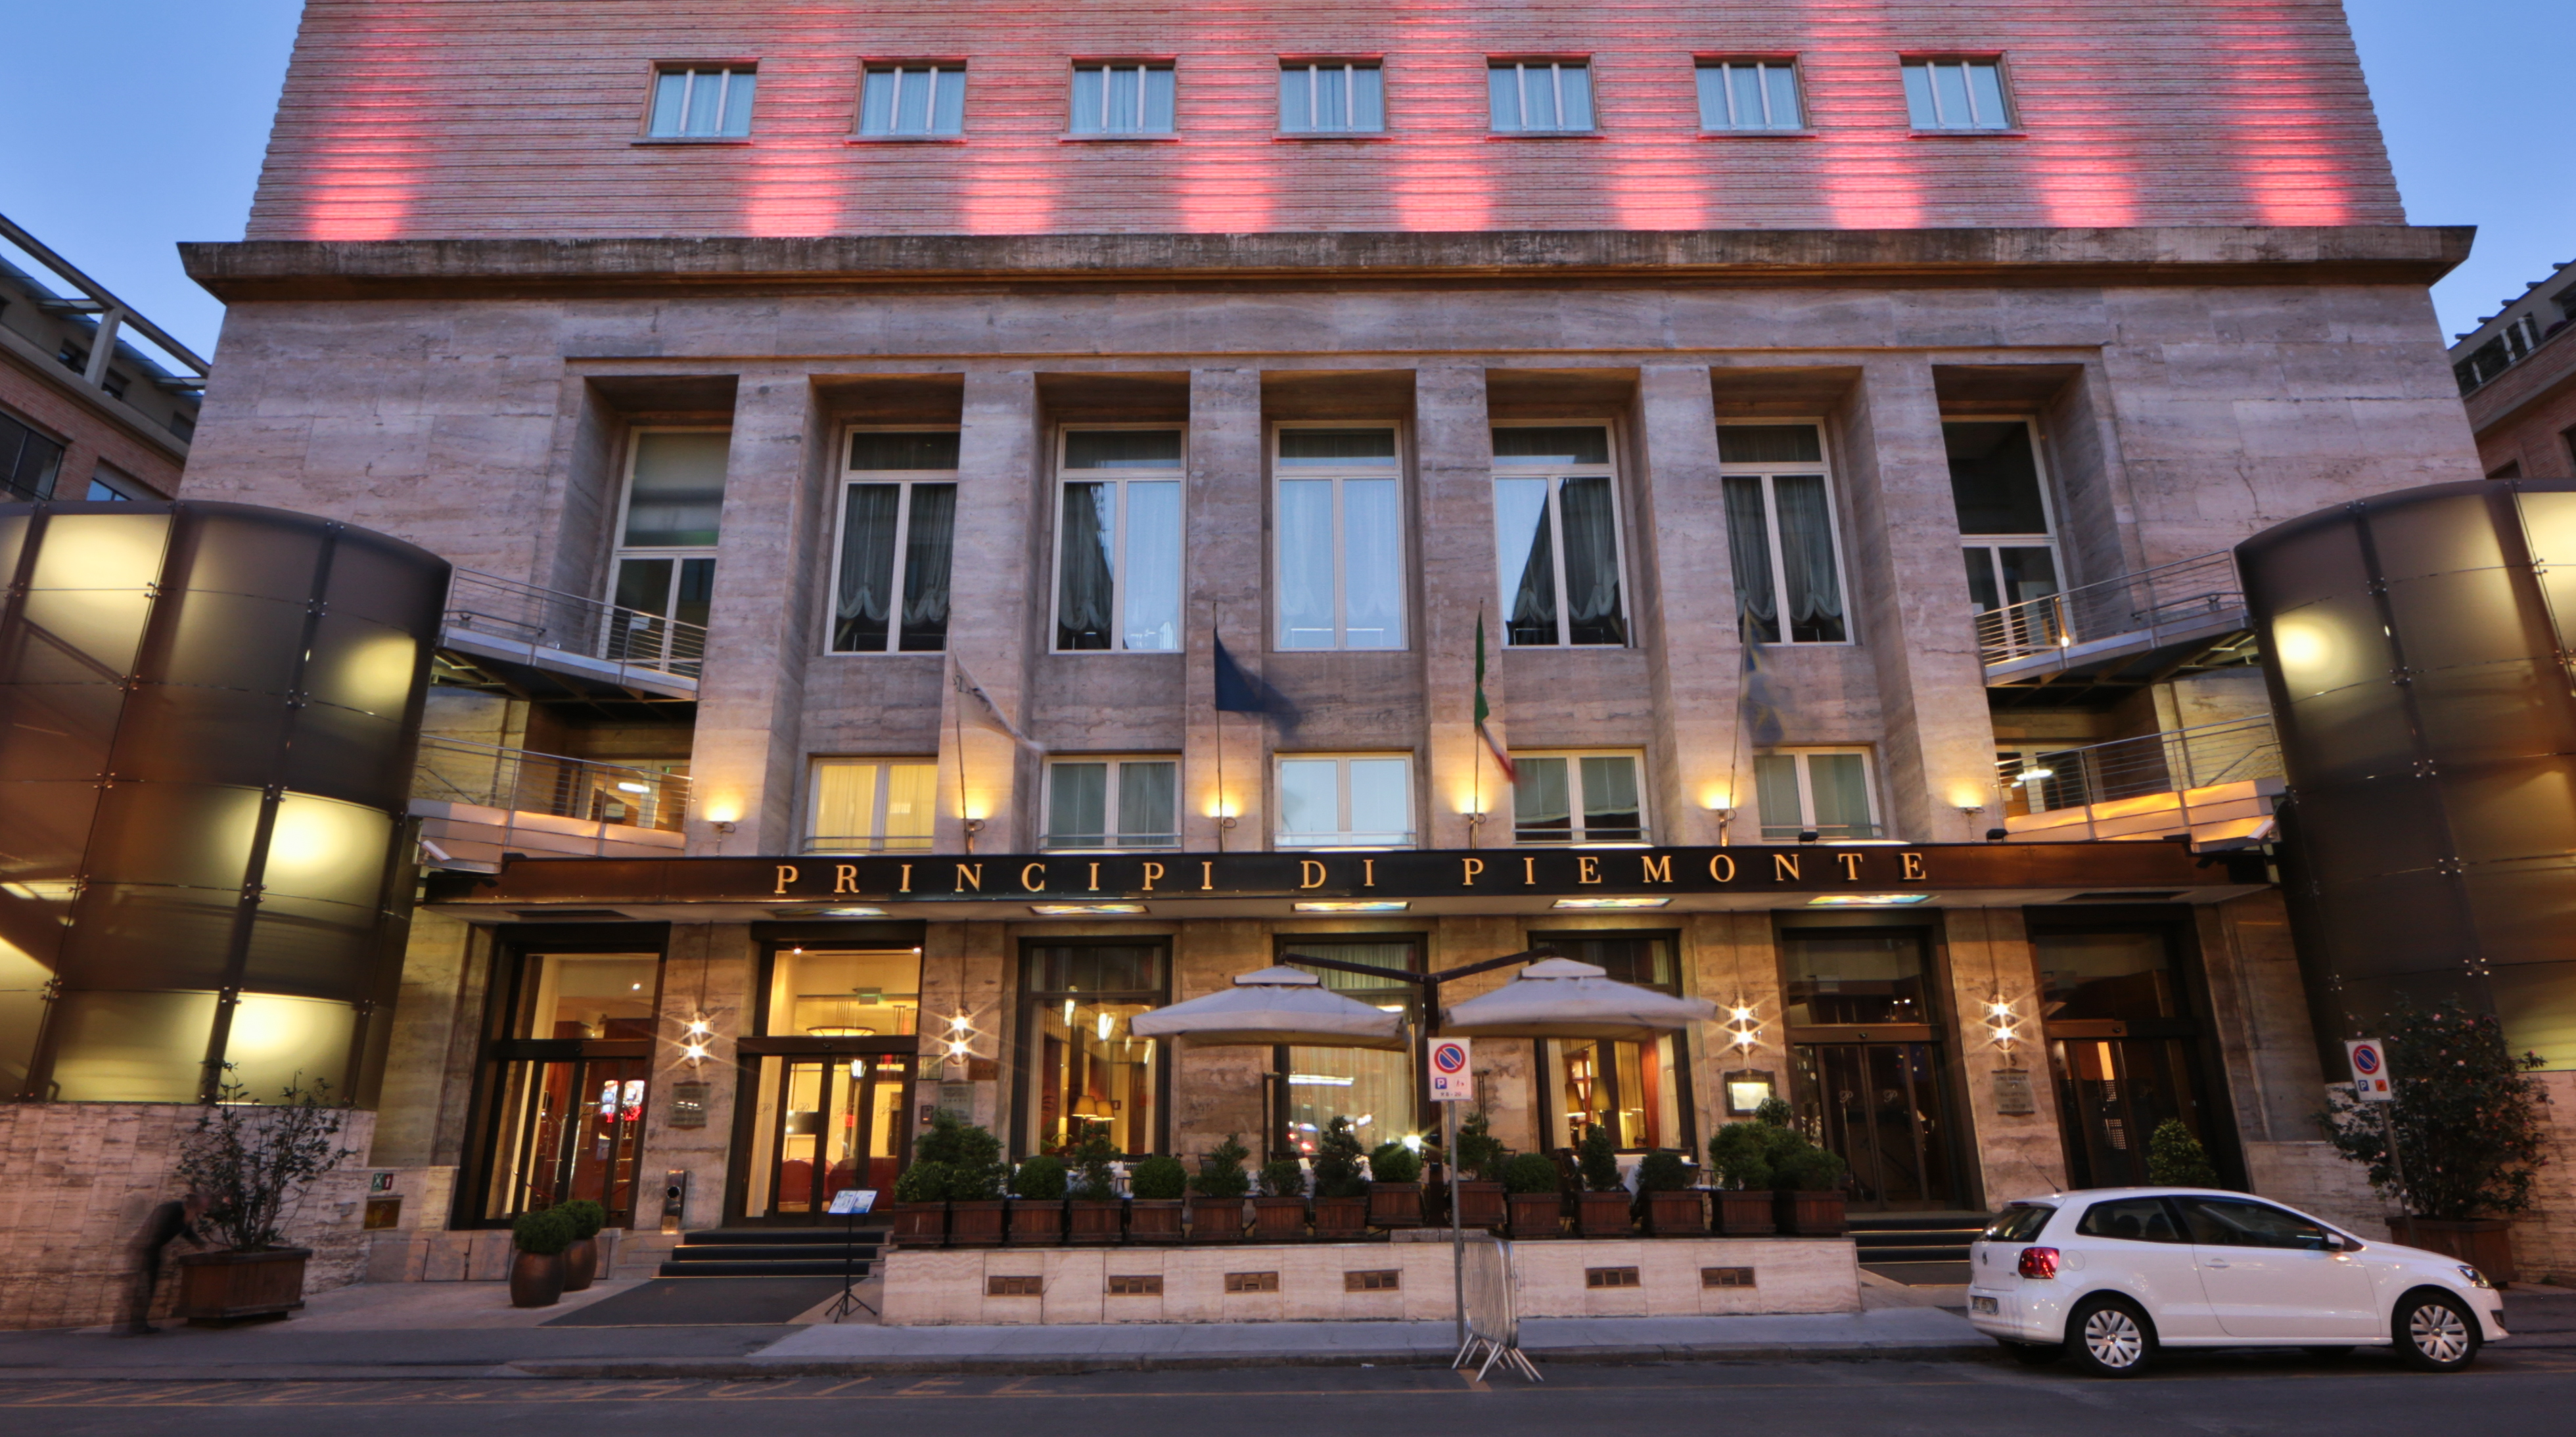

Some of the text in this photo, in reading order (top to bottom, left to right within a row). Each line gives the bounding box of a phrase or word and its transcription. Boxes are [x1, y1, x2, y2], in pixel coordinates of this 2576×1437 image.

[773, 852, 1925, 894] PRINCIPI DI PIEMONTE
